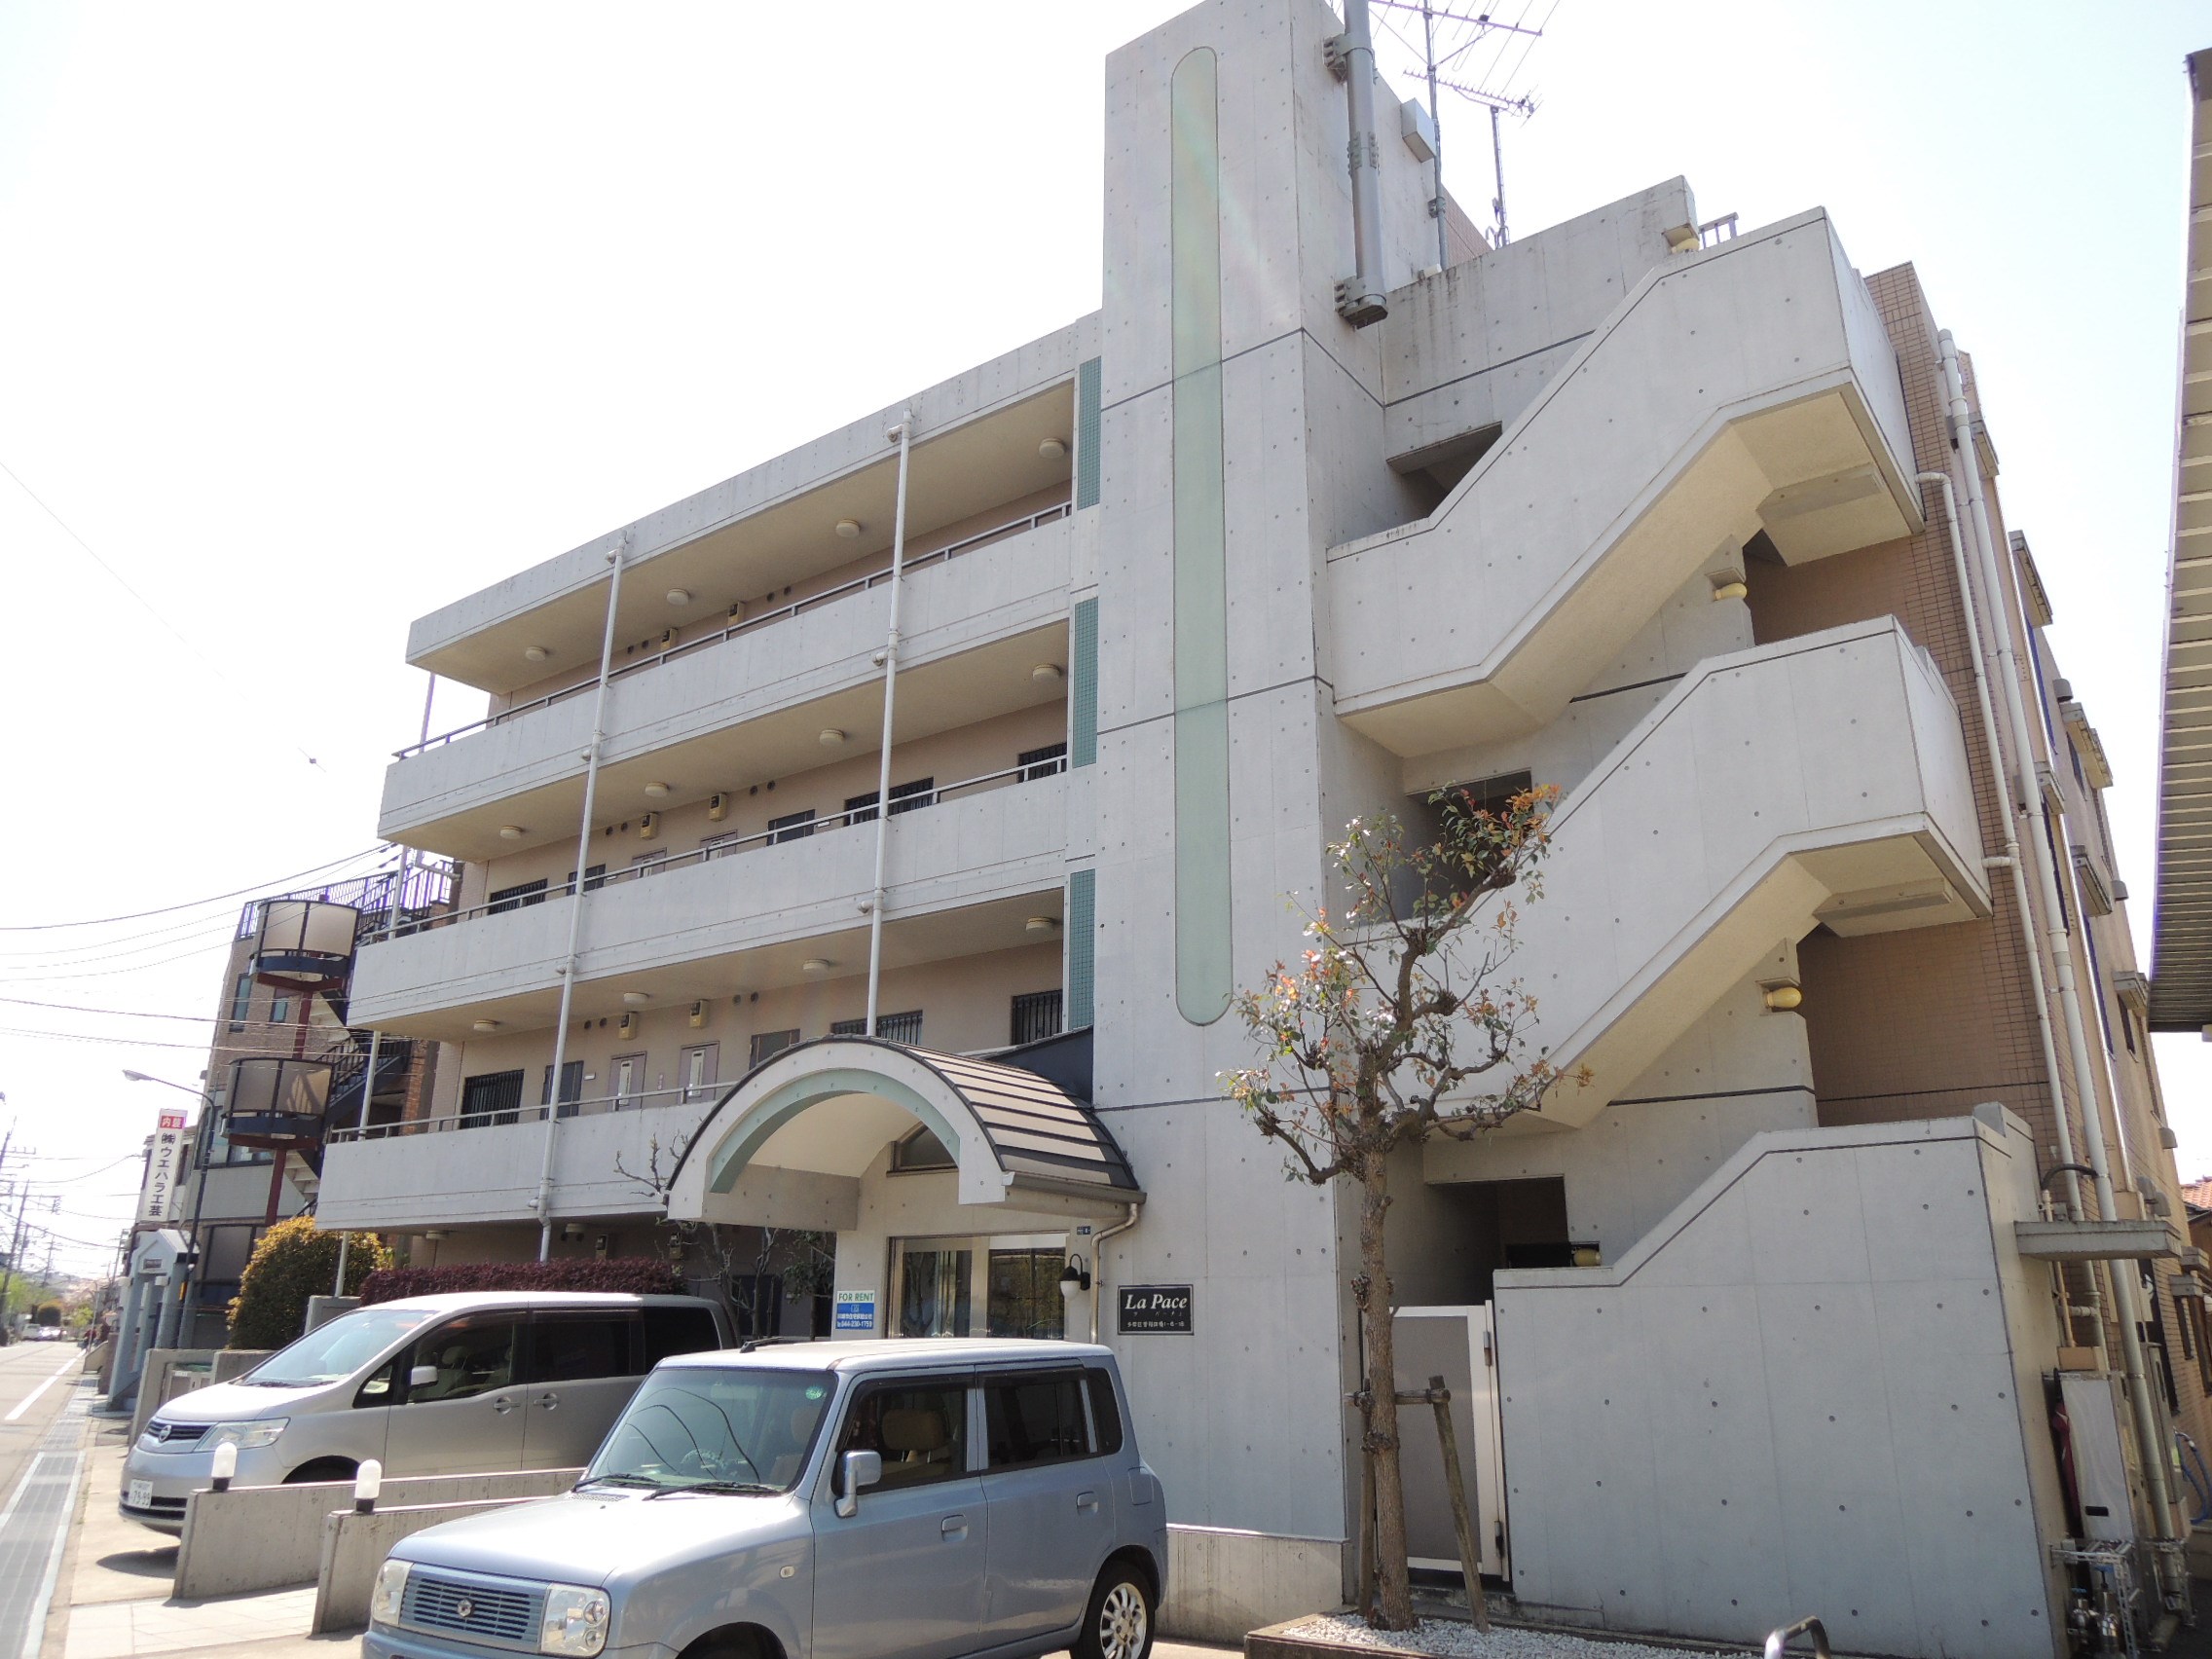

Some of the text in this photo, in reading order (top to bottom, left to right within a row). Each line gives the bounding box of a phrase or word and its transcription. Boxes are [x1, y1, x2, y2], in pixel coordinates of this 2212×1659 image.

[855, 1292, 873, 1301] RENT
[1124, 1294, 1188, 1309] La Pace
